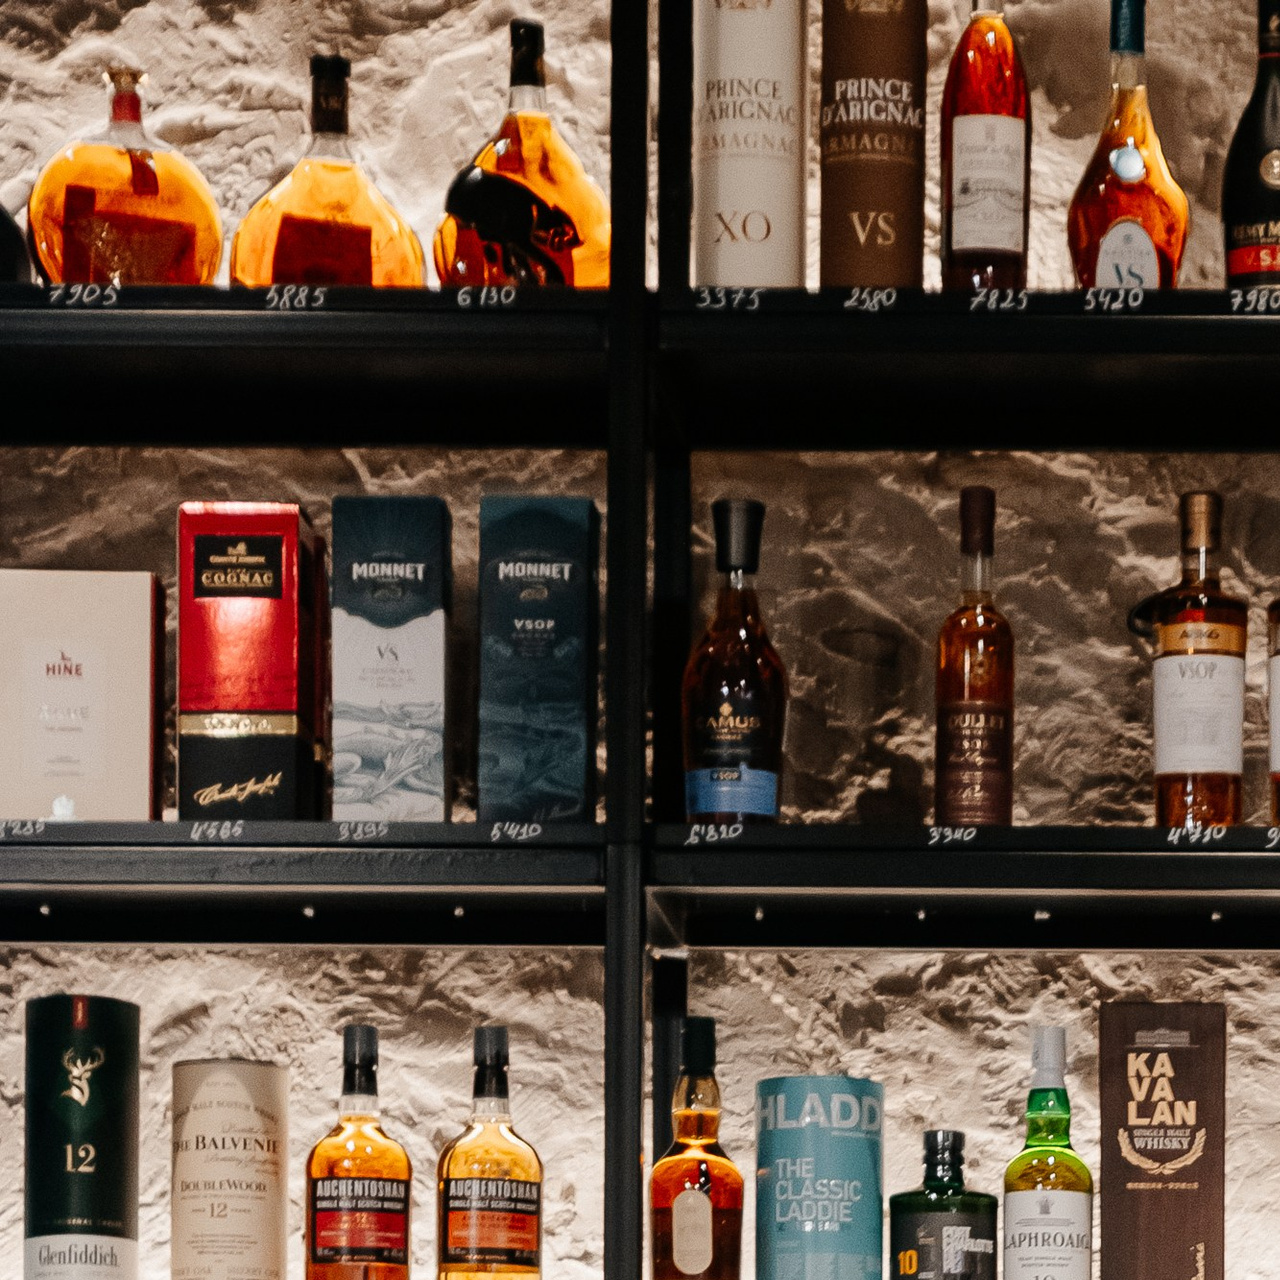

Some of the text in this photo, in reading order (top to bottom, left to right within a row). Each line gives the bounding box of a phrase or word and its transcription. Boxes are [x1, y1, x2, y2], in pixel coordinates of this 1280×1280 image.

[835, 78, 913, 101] PRINCE
[714, 210, 772, 243] XO
[848, 211, 897, 246] VS
[49, 284, 119, 305] 7905
[265, 287, 328, 309] 5885
[456, 287, 516, 306] 6130
[695, 287, 764, 310] 3375
[970, 287, 1029, 311] 7825
[1084, 288, 1143, 310] 5420
[201, 571, 273, 587] COGNAC
[352, 562, 426, 582] MONNET
[498, 562, 573, 582] MONNET
[514, 619, 555, 630] VSOP
[46, 663, 83, 676] HINE
[1133, 1137, 1191, 1150] WHISKY
[64, 1143, 96, 1174] 12
[775, 1158, 815, 1178] THE
[316, 1179, 405, 1198] AUCHENTOSHAN
[448, 1179, 538, 1200] AUCHENTOSHAN
[775, 1179, 862, 1201] CLASSIC
[209, 1202, 229, 1219] 12
[775, 1200, 853, 1222] LADDIE
[38, 1243, 119, 1267] Glenfiddich
[897, 1249, 919, 1276] 10
